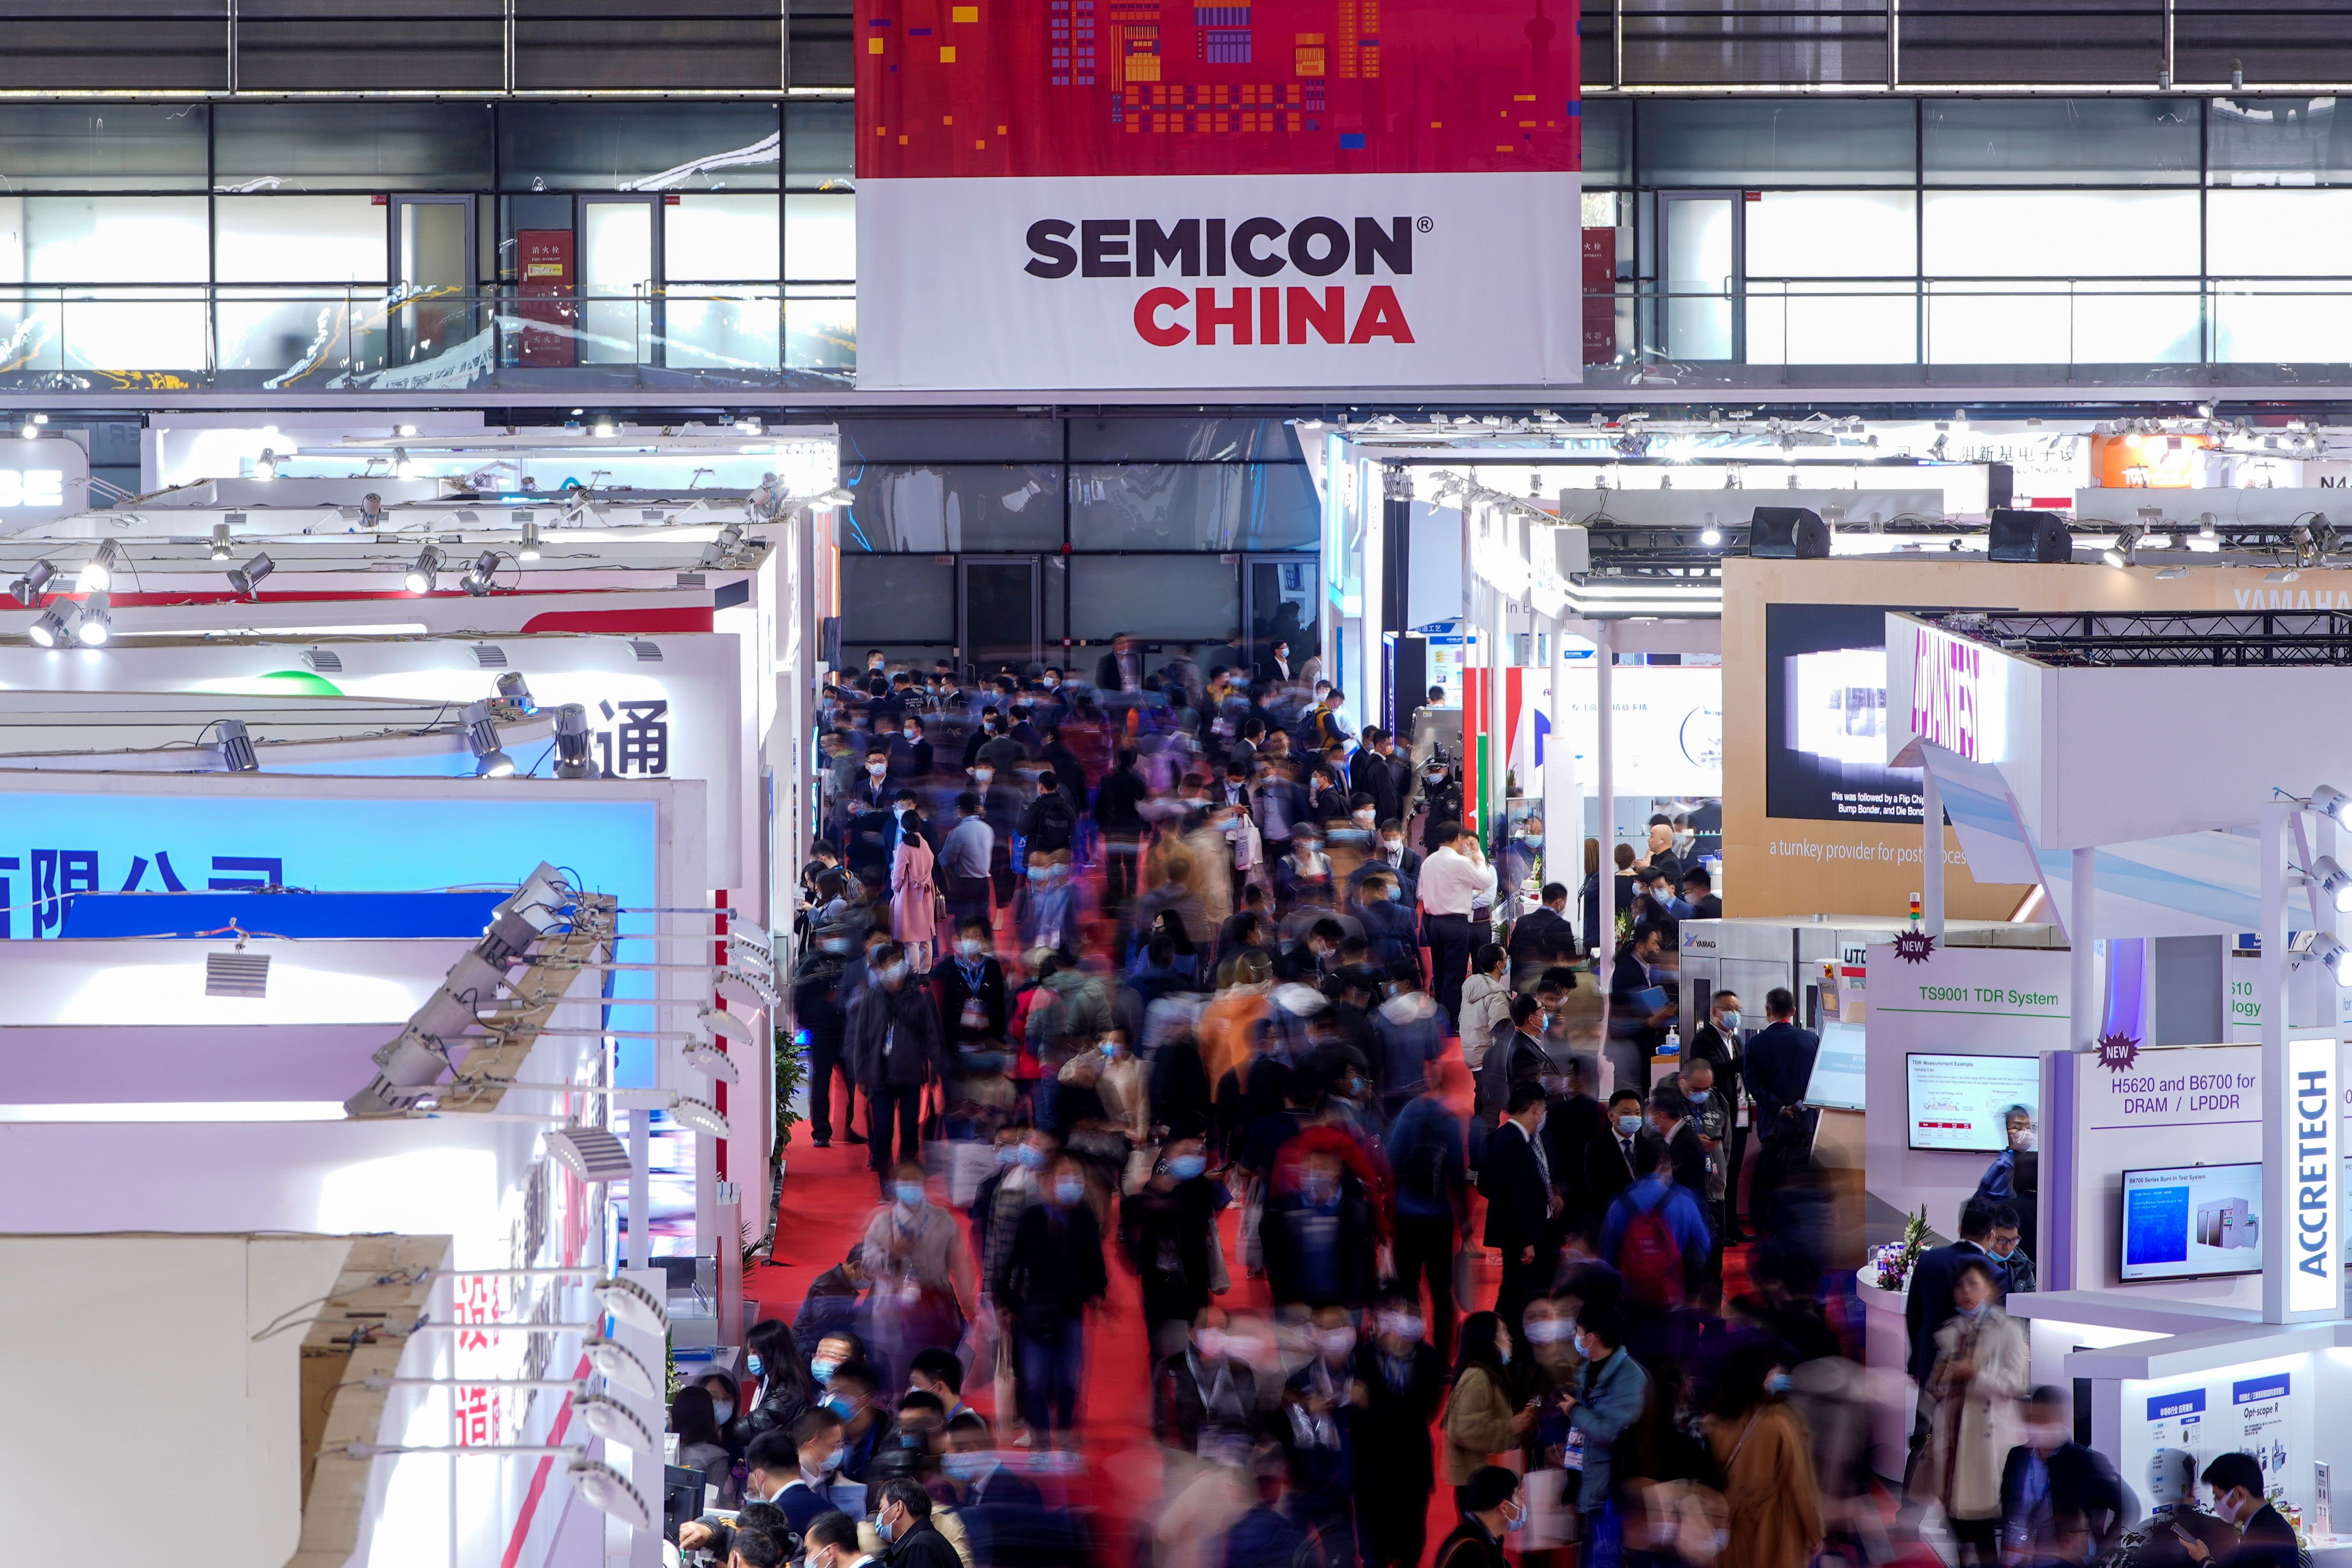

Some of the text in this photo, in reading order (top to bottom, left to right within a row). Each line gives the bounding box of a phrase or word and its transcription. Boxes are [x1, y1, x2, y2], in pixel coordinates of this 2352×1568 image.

[532, 246, 559, 254] 消火栓
[1134, 286, 1416, 347] CHINA
[2233, 588, 2352, 610] YAMAHA
[1831, 791, 1843, 801] this
[1844, 793, 1857, 802] was
[1857, 792, 1883, 803] followed
[1884, 793, 1893, 805] by
[1898, 794, 1910, 805] Flip
[1838, 803, 1857, 816] Bump
[1858, 804, 1882, 816] Bonder,
[1883, 806, 1895, 815] and
[1896, 806, 1907, 816] Die
[1770, 841, 1776, 855] a
[1779, 838, 1823, 862] turnkey
[1826, 840, 1875, 863] provider
[1877, 841, 1895, 861] for
[1902, 940, 1925, 952] NEW
[1919, 986, 2059, 1007] TS9001 TDR System
[2106, 1045, 2129, 1059] NEW
[2112, 1073, 2256, 1094] H5620 and B6700 for
[2124, 1094, 2240, 1114] DRAM / LPDDR
[2298, 1070, 2327, 1279] ACCRETECH
[2244, 1402, 2278, 1421] Opt-scope R
